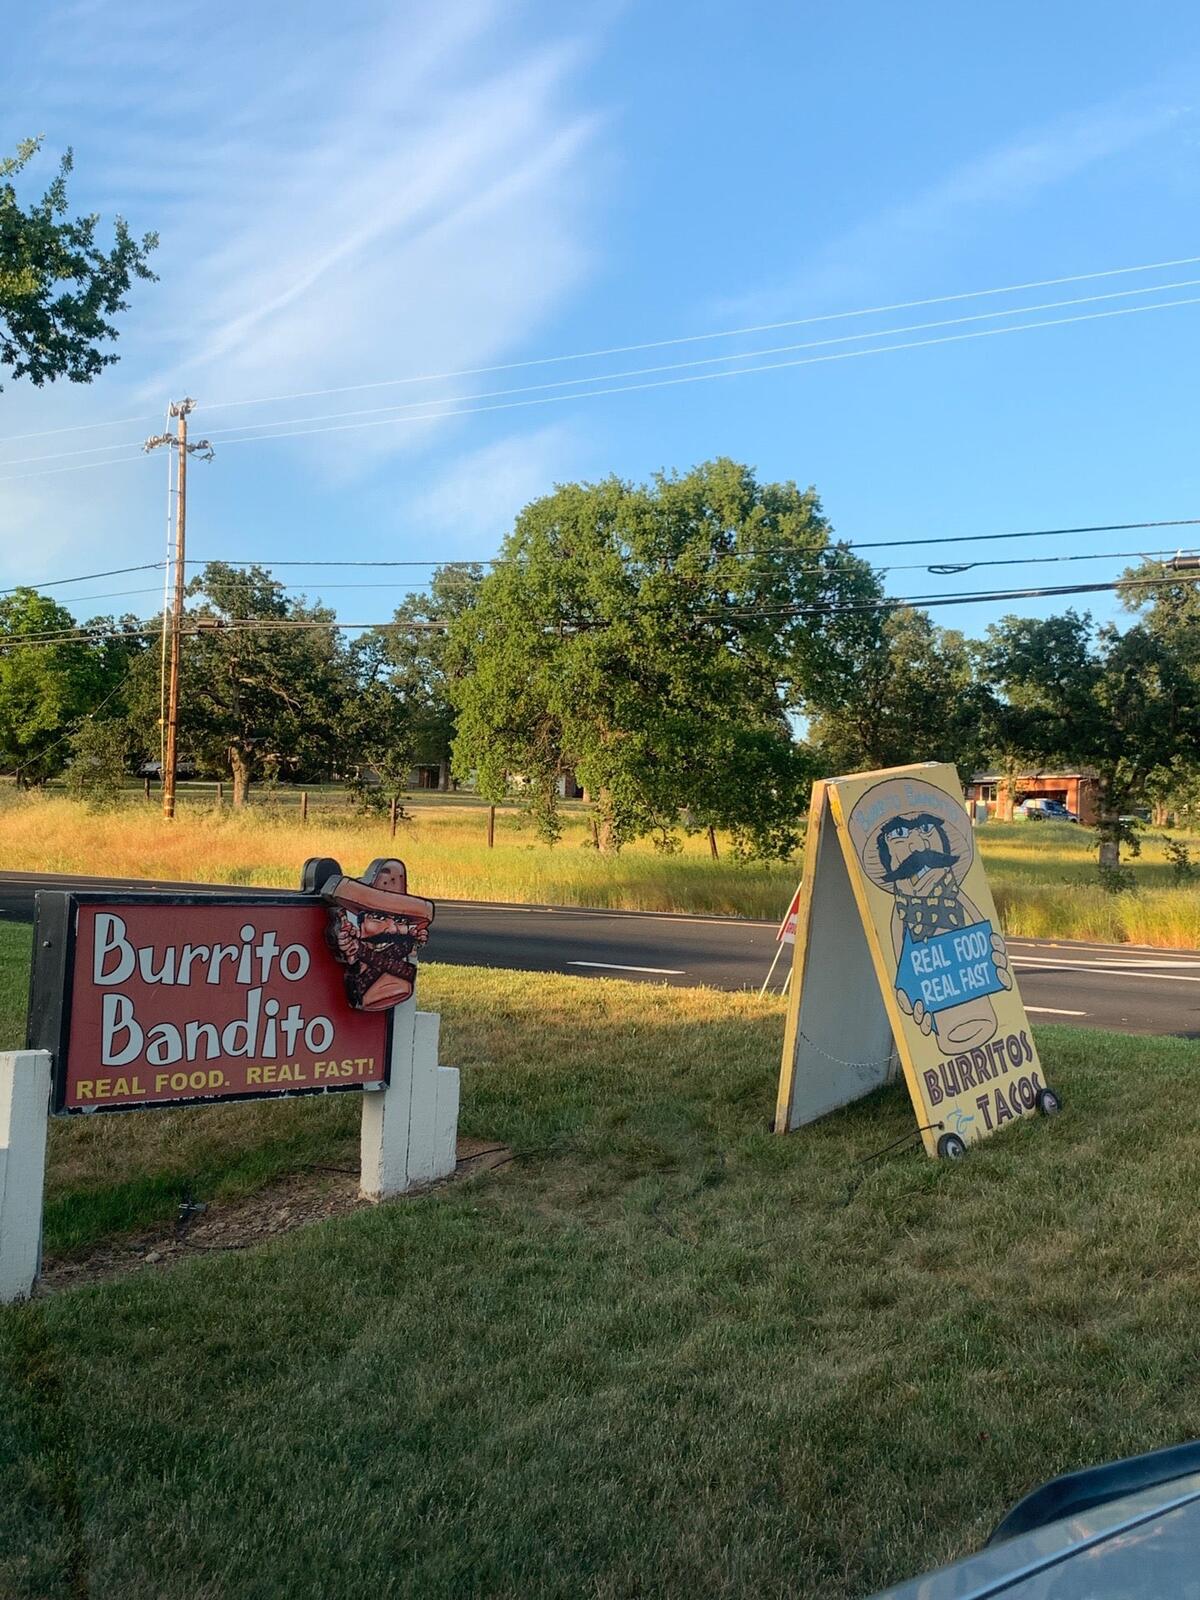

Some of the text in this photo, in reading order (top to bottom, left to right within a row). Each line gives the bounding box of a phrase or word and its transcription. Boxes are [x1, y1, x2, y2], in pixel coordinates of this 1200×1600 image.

[93, 913, 310, 986] Burrito
[911, 931, 988, 976] REAL FOOD
[920, 961, 990, 1006] REAL FAST
[101, 987, 335, 1066] Bandito
[76, 1058, 375, 1099] REAL FOOD. REAL FAST!
[923, 1031, 1033, 1106] BURRITOS
